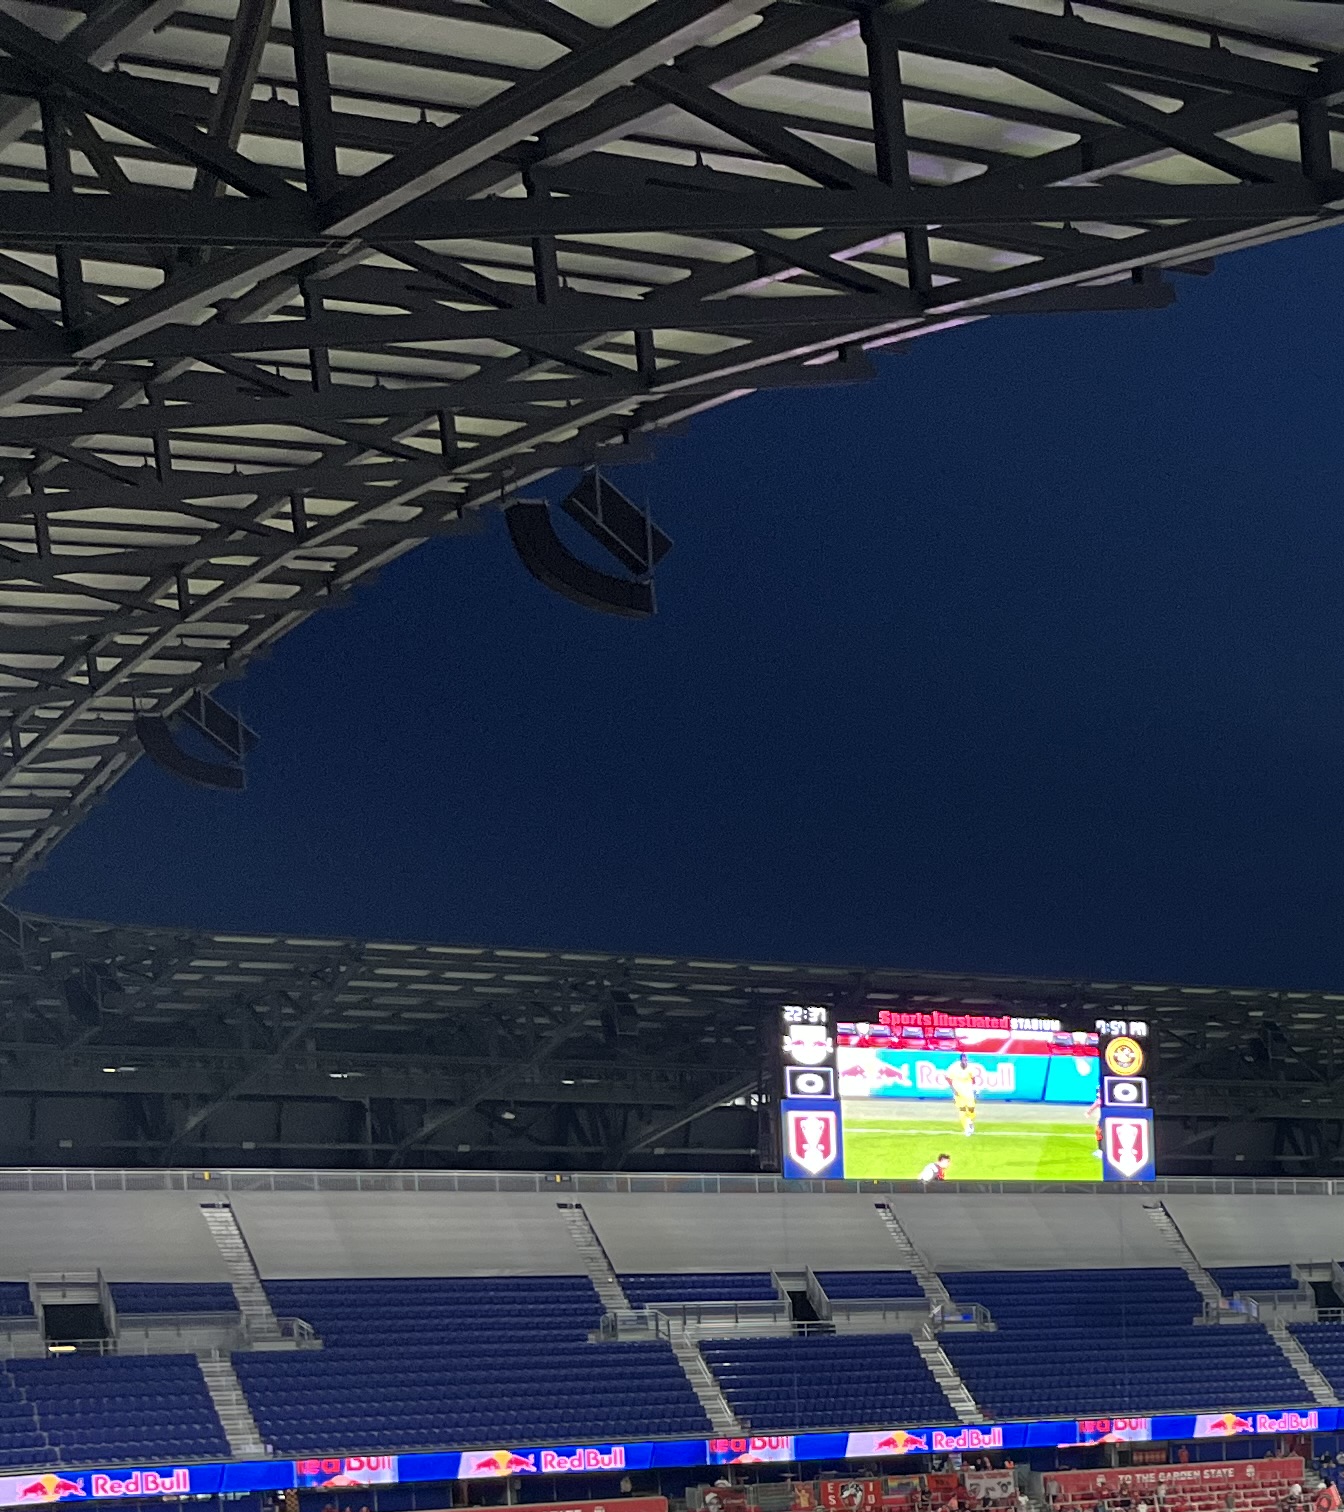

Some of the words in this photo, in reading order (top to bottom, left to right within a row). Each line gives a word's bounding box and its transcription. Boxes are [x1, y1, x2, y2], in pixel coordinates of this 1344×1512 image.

[879, 1010, 931, 1027] Sports
[932, 1011, 1010, 1030] Illustrated
[1257, 1413, 1288, 1432] Red
[1288, 1411, 1318, 1430] Bull
[932, 1430, 968, 1449] Red
[969, 1427, 1002, 1448] Bull
[541, 1450, 583, 1472] Red
[584, 1447, 625, 1470] Bull
[92, 1471, 140, 1497] Red
[142, 1469, 190, 1494] Bull
[1136, 1473, 1156, 1482] THE
[1158, 1471, 1201, 1482] GARDEN
[1203, 1468, 1234, 1479] STATE
